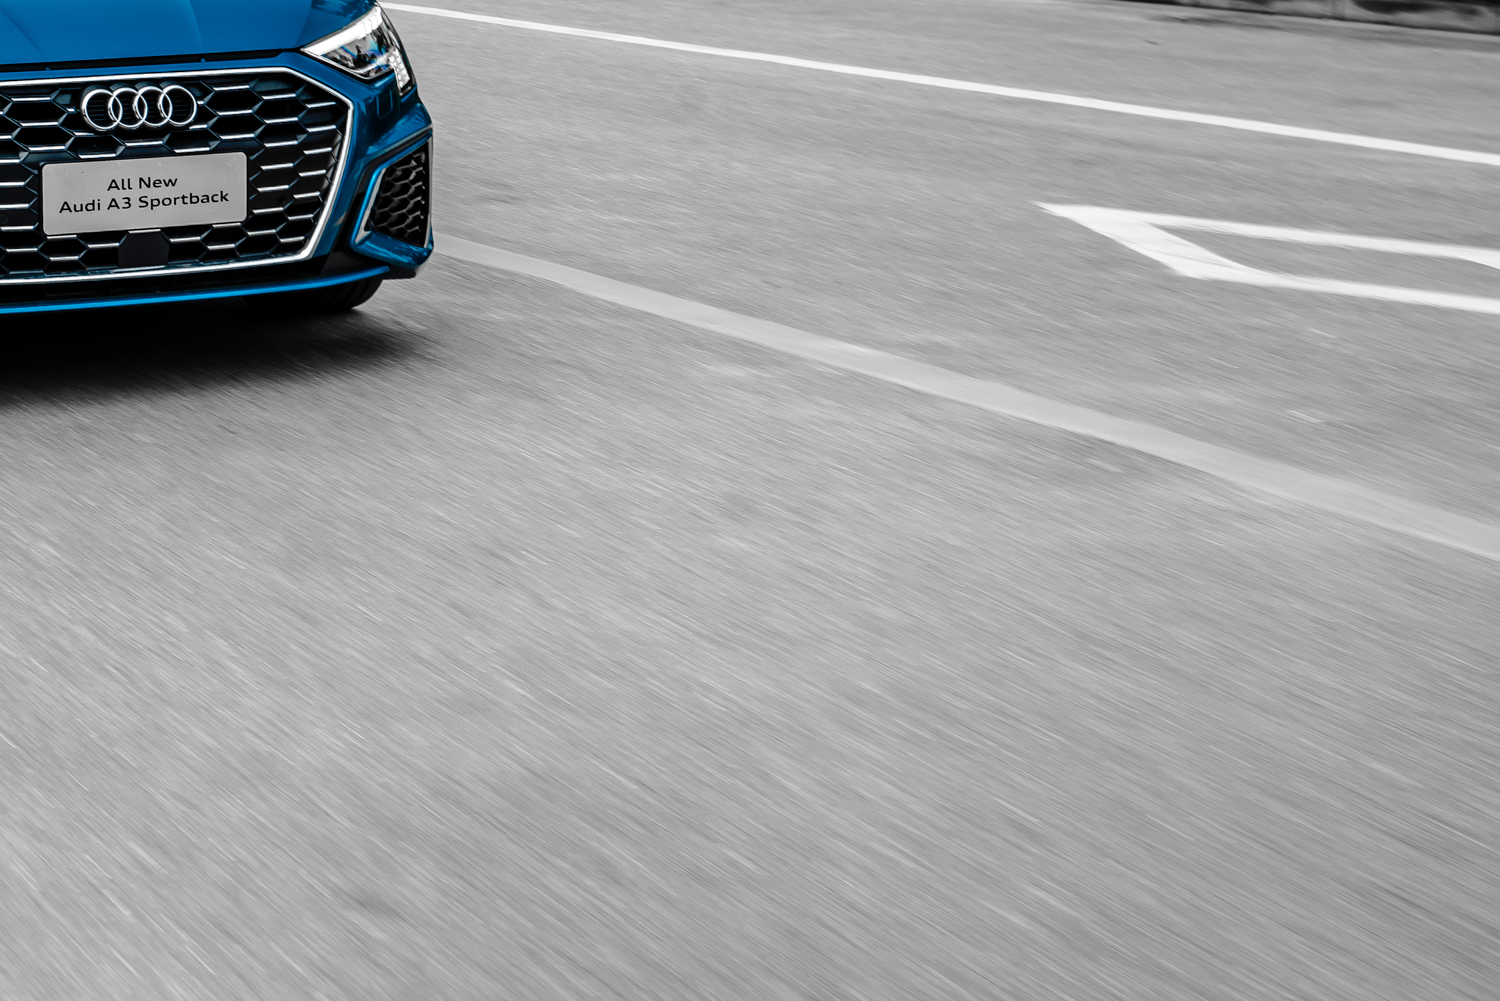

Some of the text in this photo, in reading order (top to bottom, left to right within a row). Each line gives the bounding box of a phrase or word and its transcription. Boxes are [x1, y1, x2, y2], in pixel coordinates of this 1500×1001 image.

[107, 176, 178, 191] All New
[59, 190, 229, 213] Audi A3 Sportback
